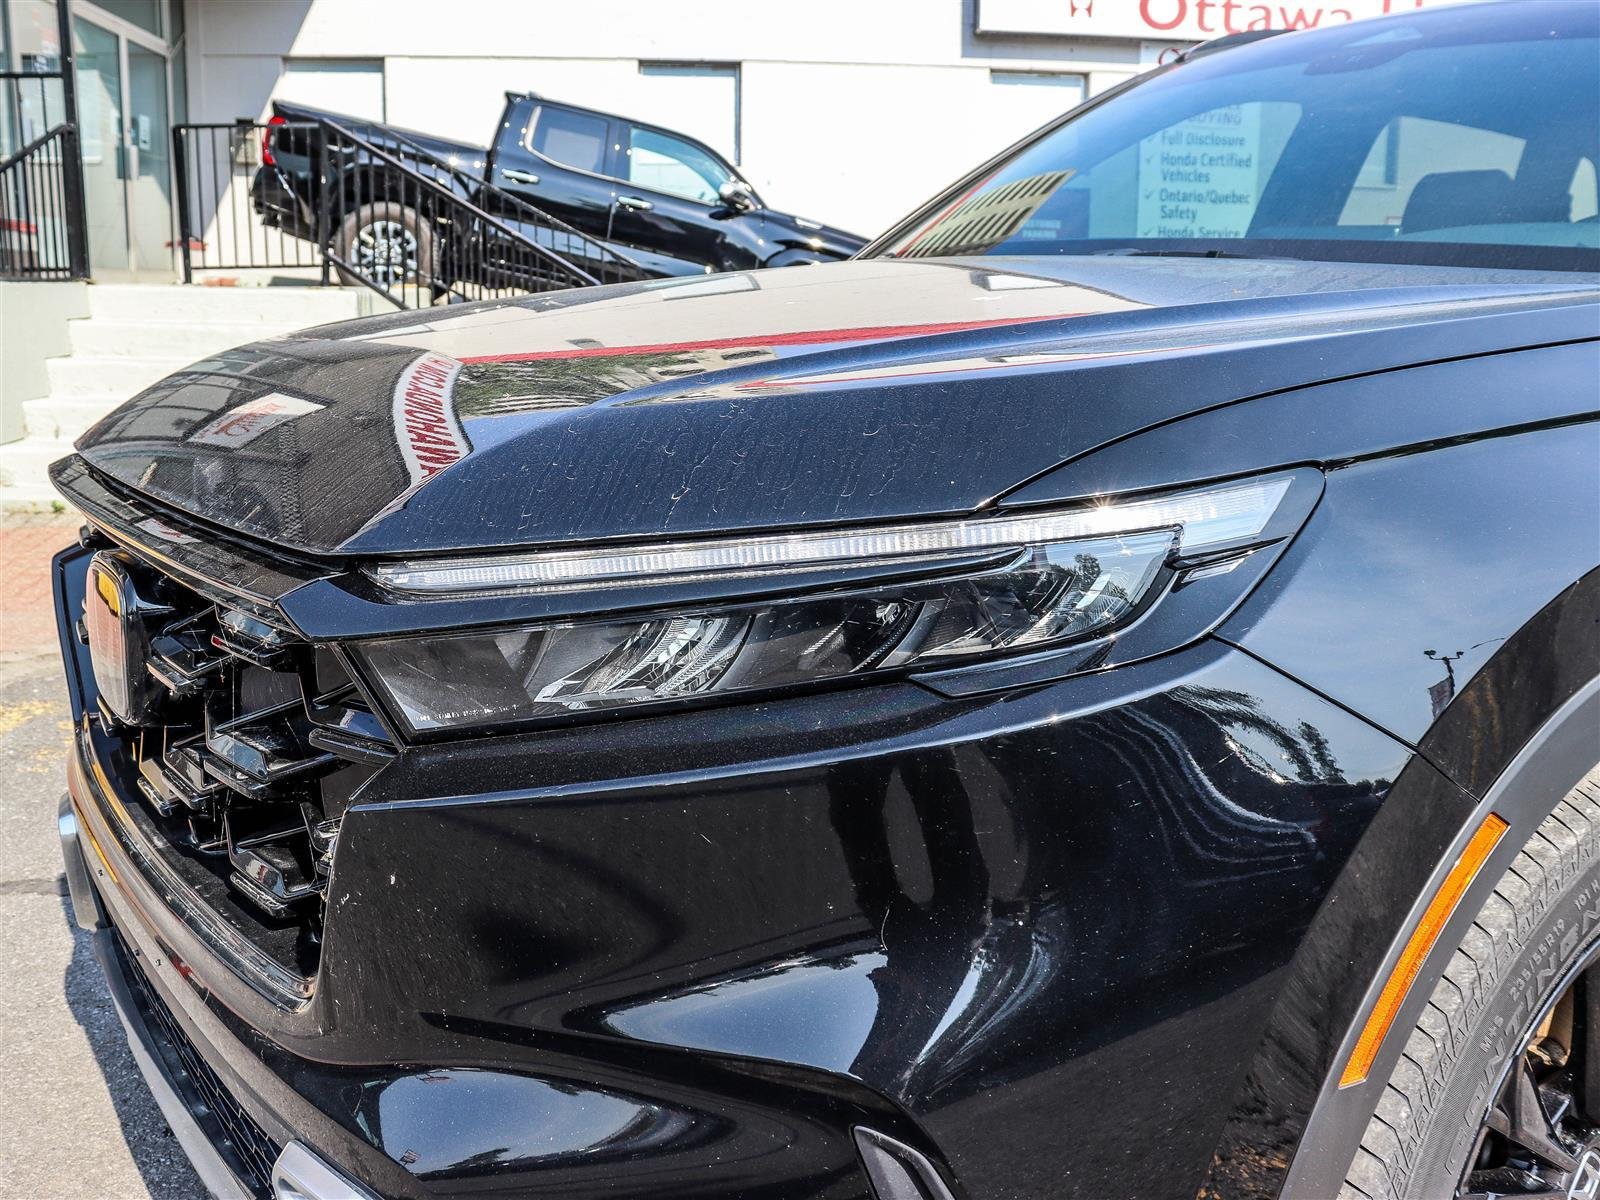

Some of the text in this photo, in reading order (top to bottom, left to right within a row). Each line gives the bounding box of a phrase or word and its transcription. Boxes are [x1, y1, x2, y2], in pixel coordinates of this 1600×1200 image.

[1161, 130, 1246, 146] Full Disclosure
[1160, 151, 1252, 168] Honda Certified
[1161, 168, 1210, 183] Vehicles
[1160, 188, 1250, 204] Ontario/Quebec
[1160, 205, 1198, 222] Safety
[1157, 226, 1195, 238] Honda
